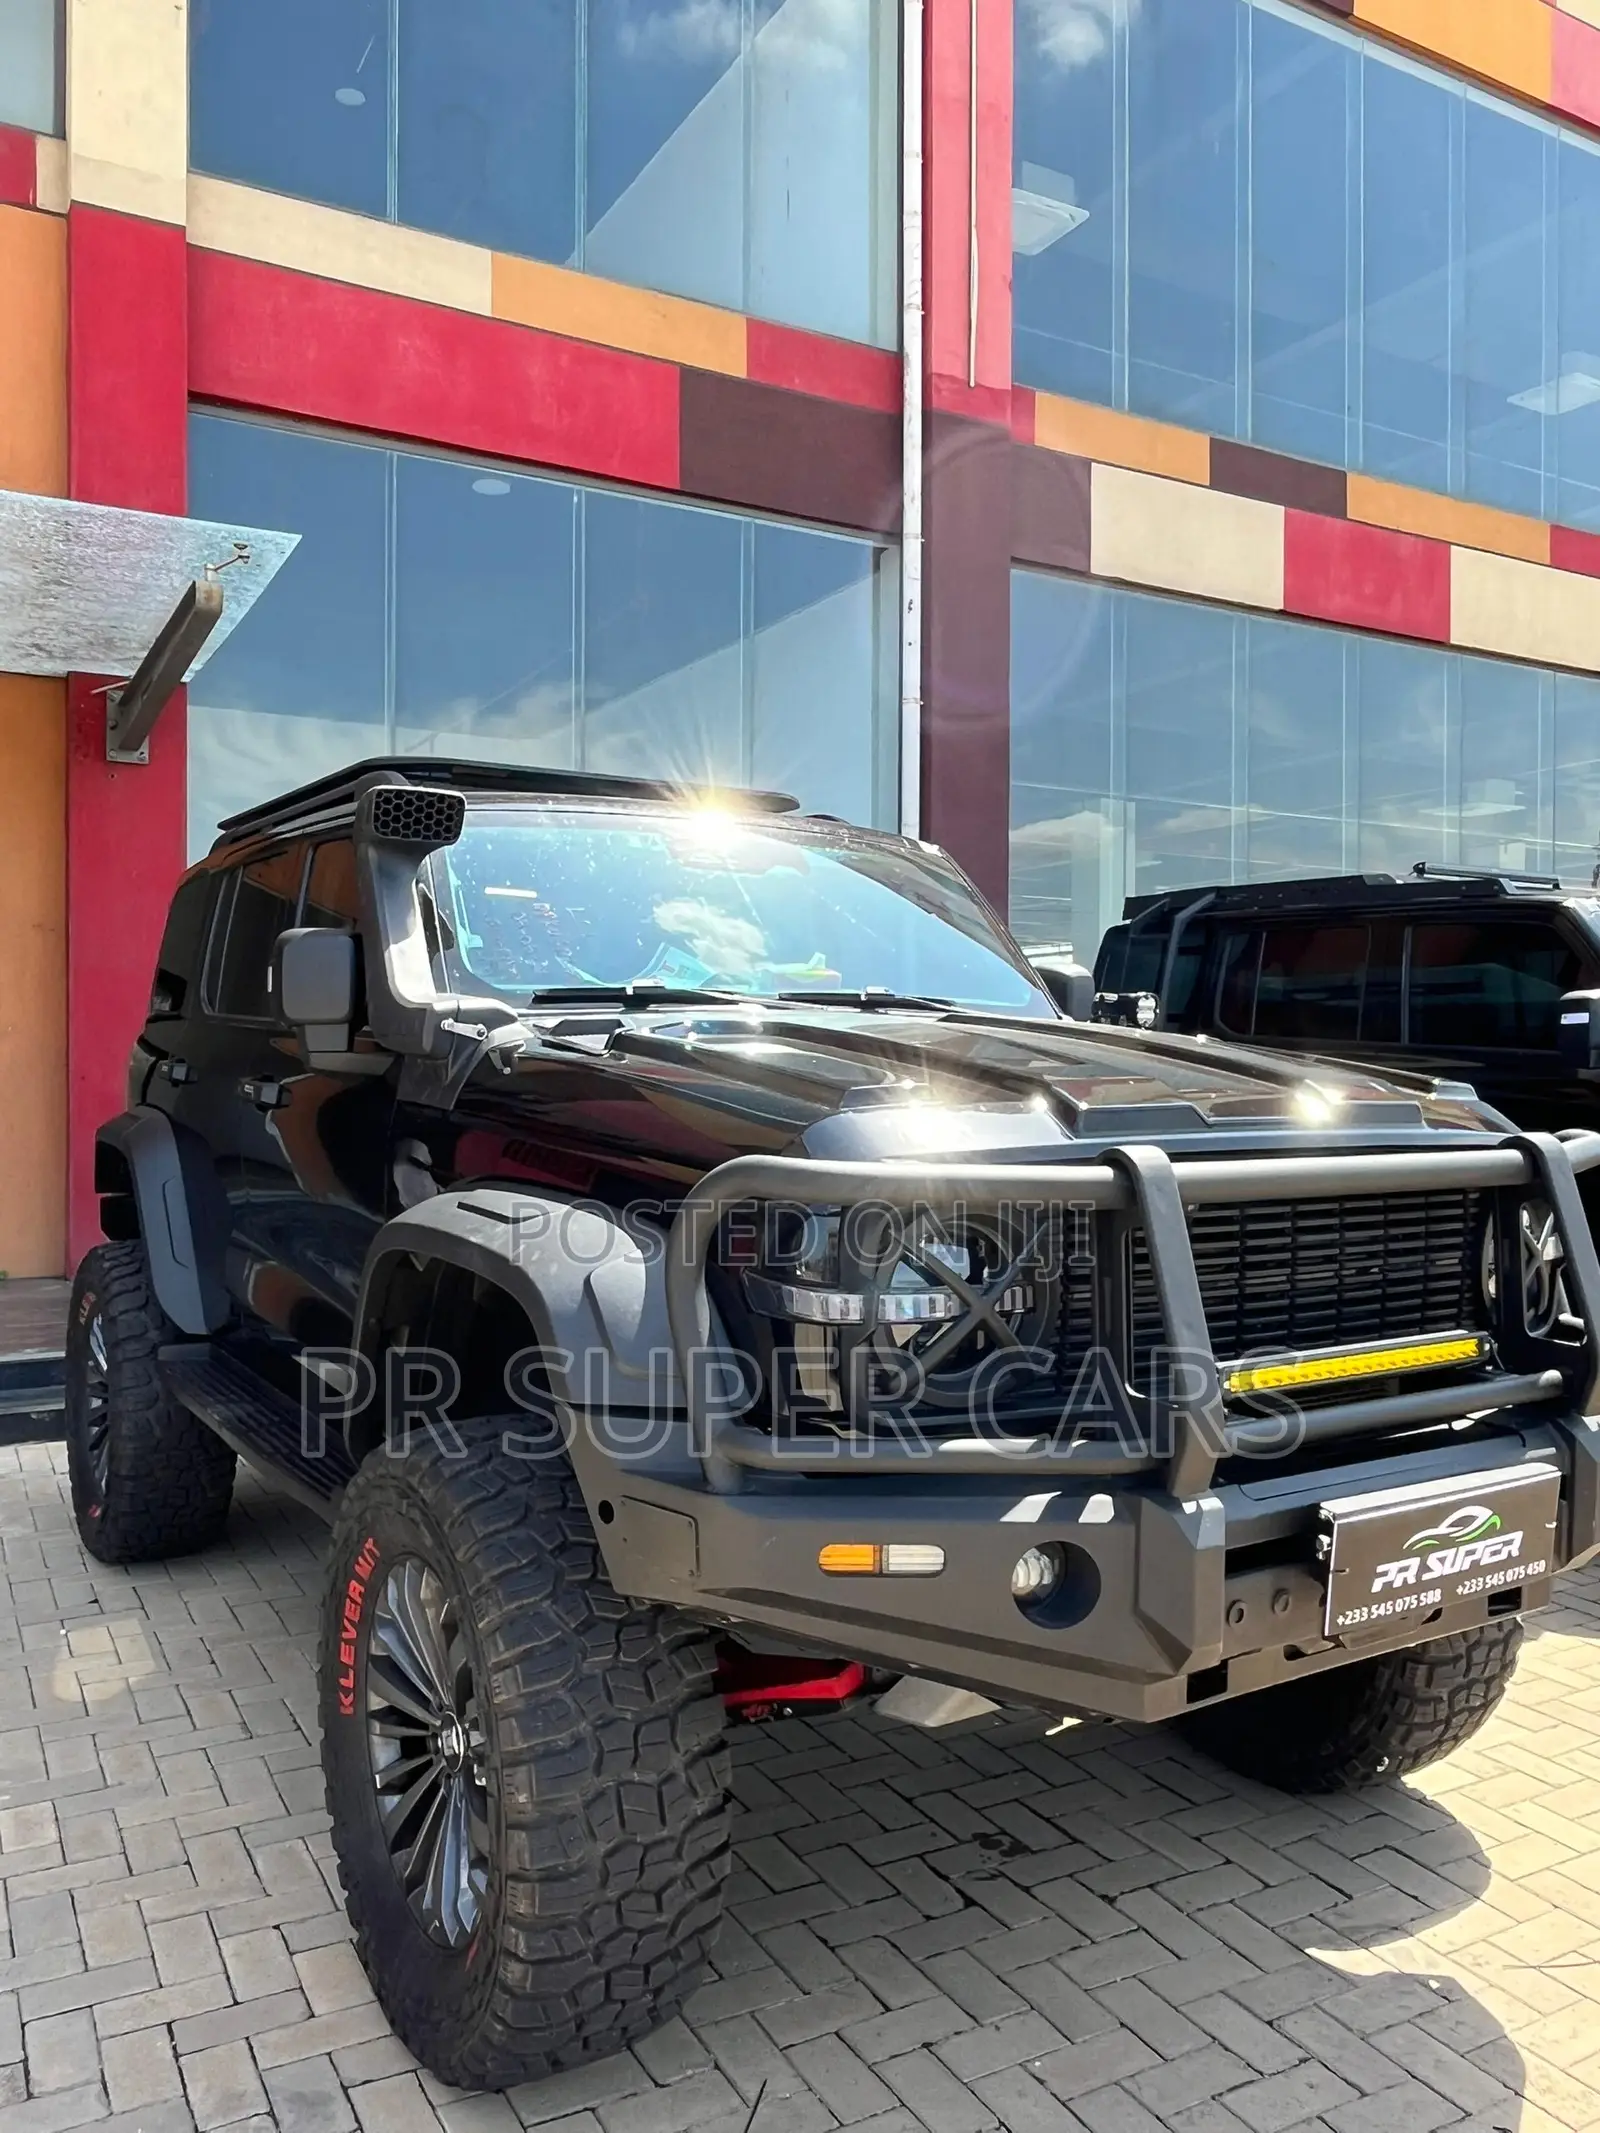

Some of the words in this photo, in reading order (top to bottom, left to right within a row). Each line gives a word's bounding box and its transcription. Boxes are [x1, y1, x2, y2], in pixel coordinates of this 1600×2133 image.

[1371, 1557, 1421, 1593] PR
[1421, 1531, 1523, 1581] SUPER
[1456, 1577, 1484, 1596] +233
[1485, 1570, 1506, 1588] 545
[1506, 1565, 1526, 1582] 075
[1526, 1559, 1546, 1576] 450
[1336, 1607, 1370, 1626] +233
[1370, 1600, 1394, 1619] 545
[1395, 1594, 1419, 1613] 075
[1419, 1588, 1442, 1607] 588
[339, 1580, 366, 1714] KLEVER
